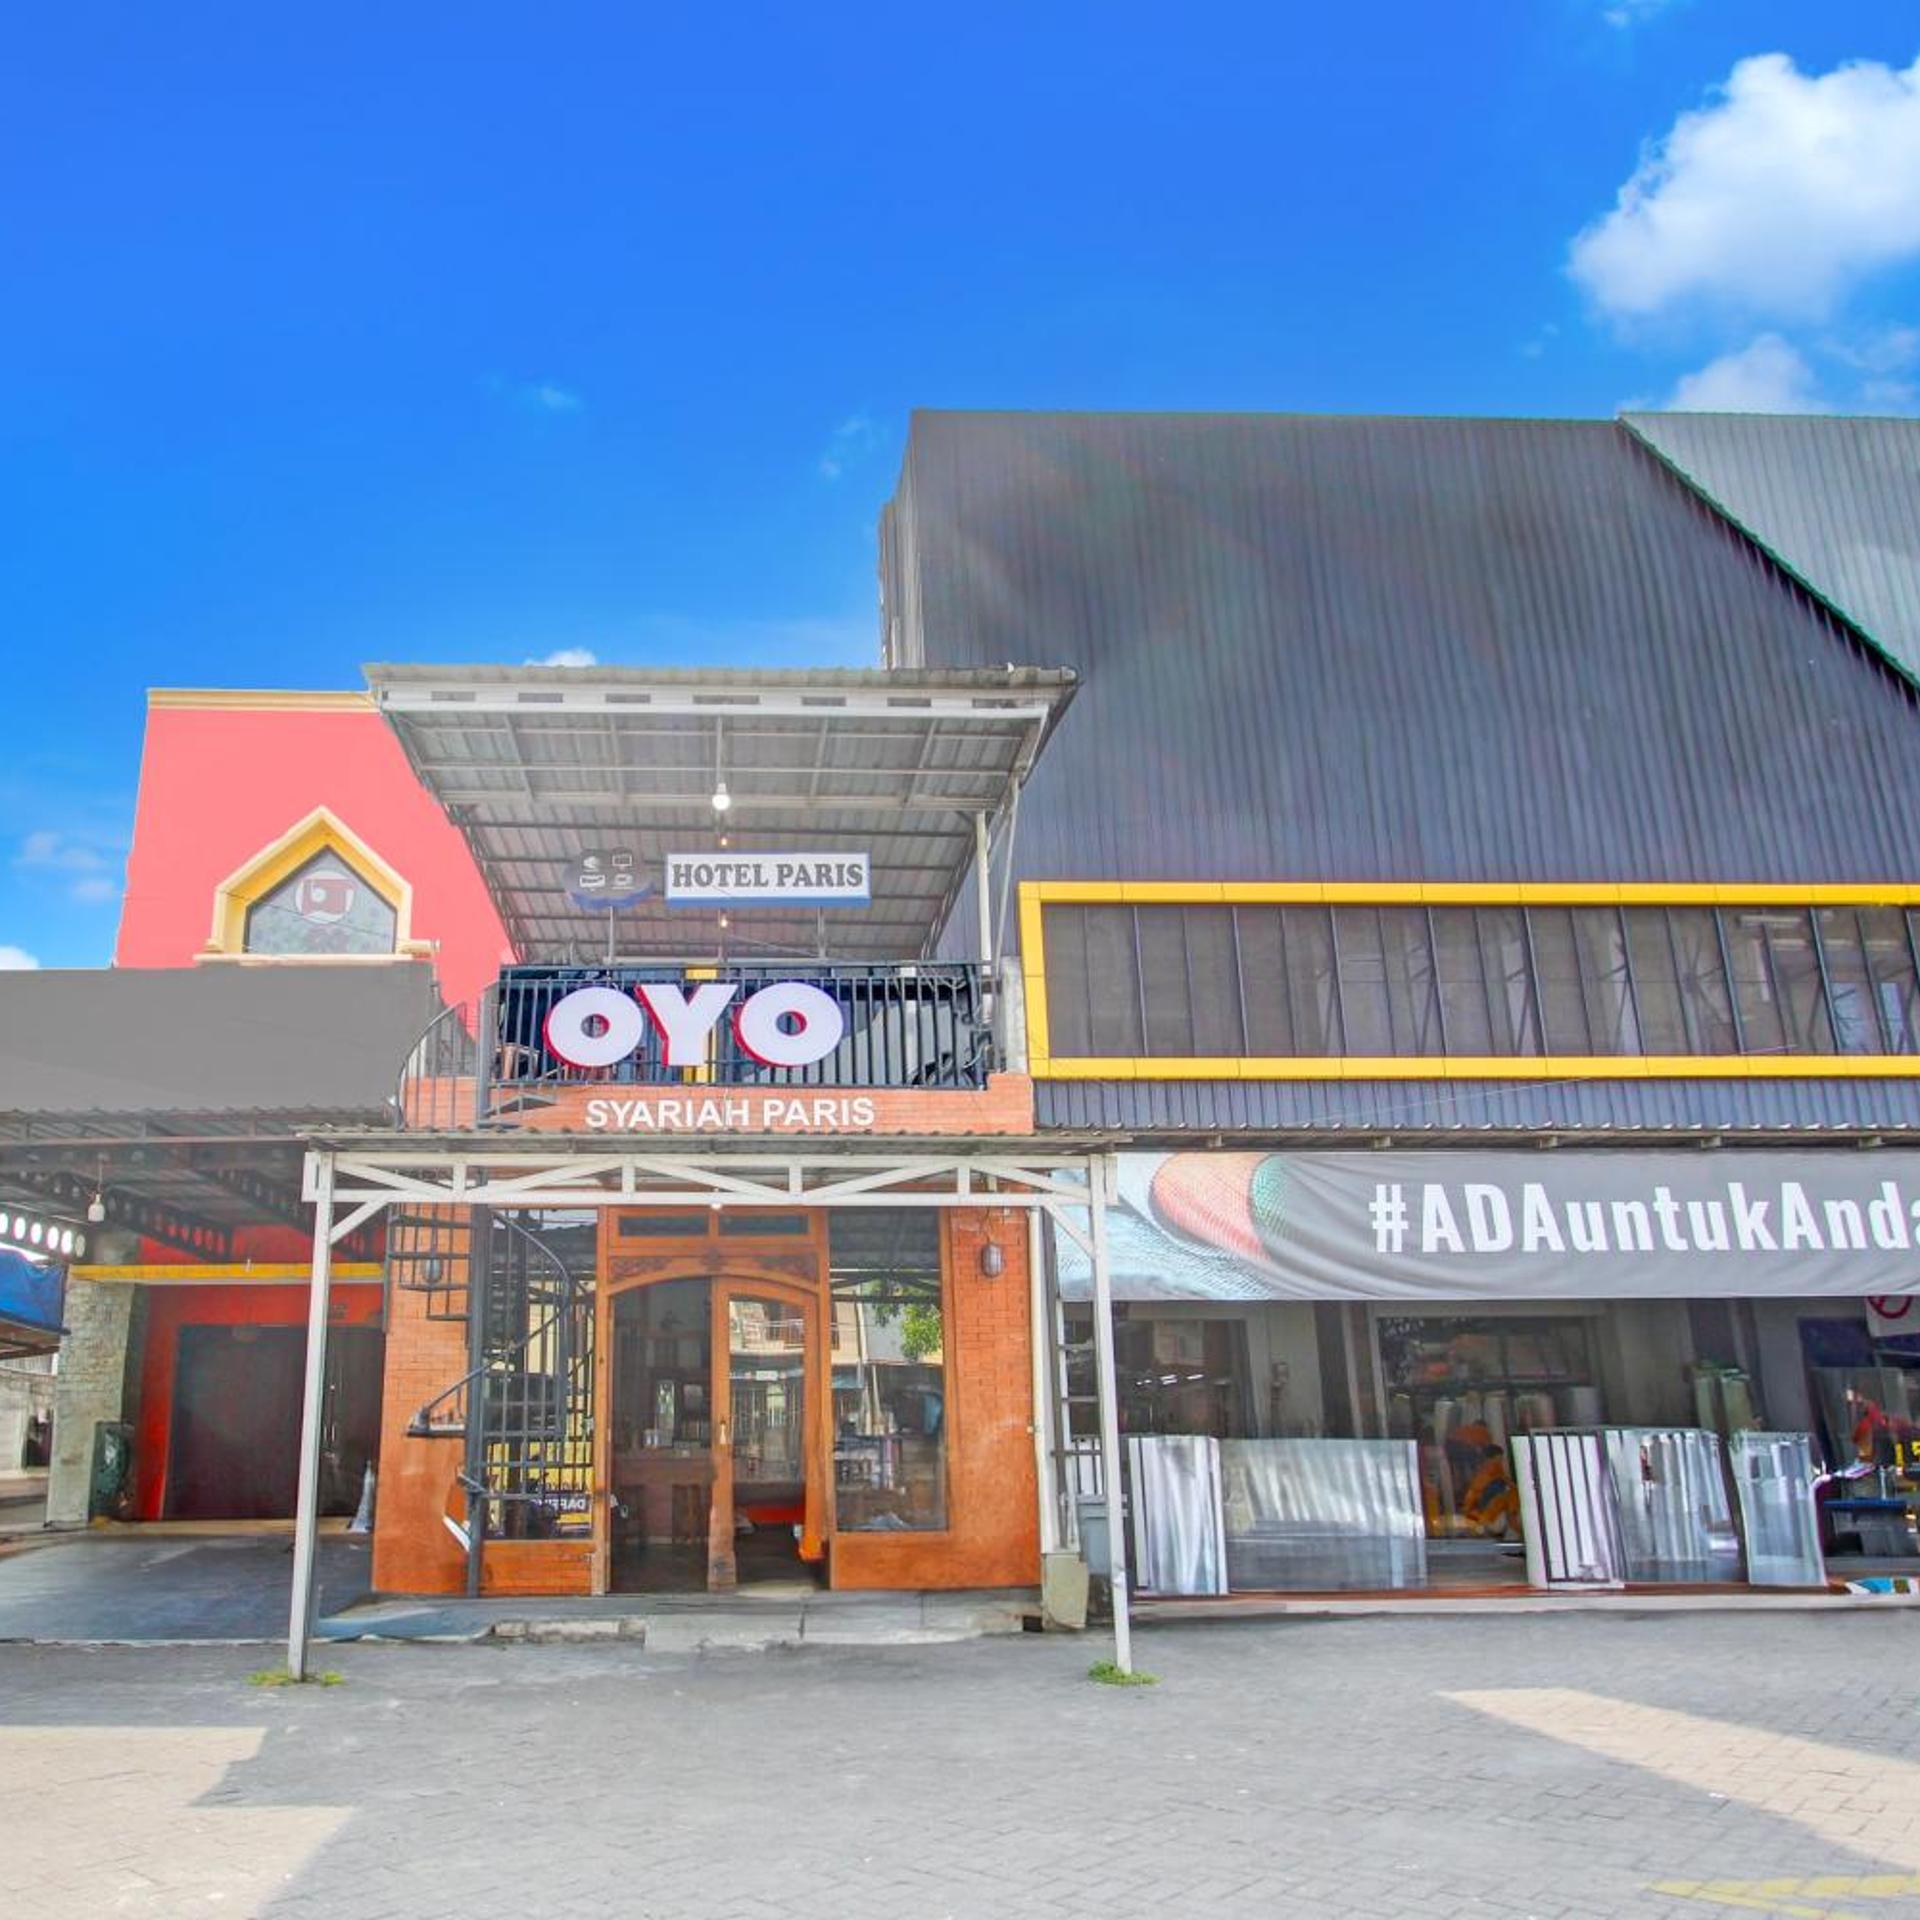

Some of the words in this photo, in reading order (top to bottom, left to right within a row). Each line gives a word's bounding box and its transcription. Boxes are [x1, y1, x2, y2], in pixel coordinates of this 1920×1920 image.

[672, 863, 769, 888] HOTEL
[776, 863, 864, 888] PARIS
[542, 982, 844, 1068] OYO
[585, 1099, 748, 1128] SYARIAH
[763, 1098, 875, 1126] PARIS
[1368, 1182, 1920, 1253] #ADAuntukAnd
